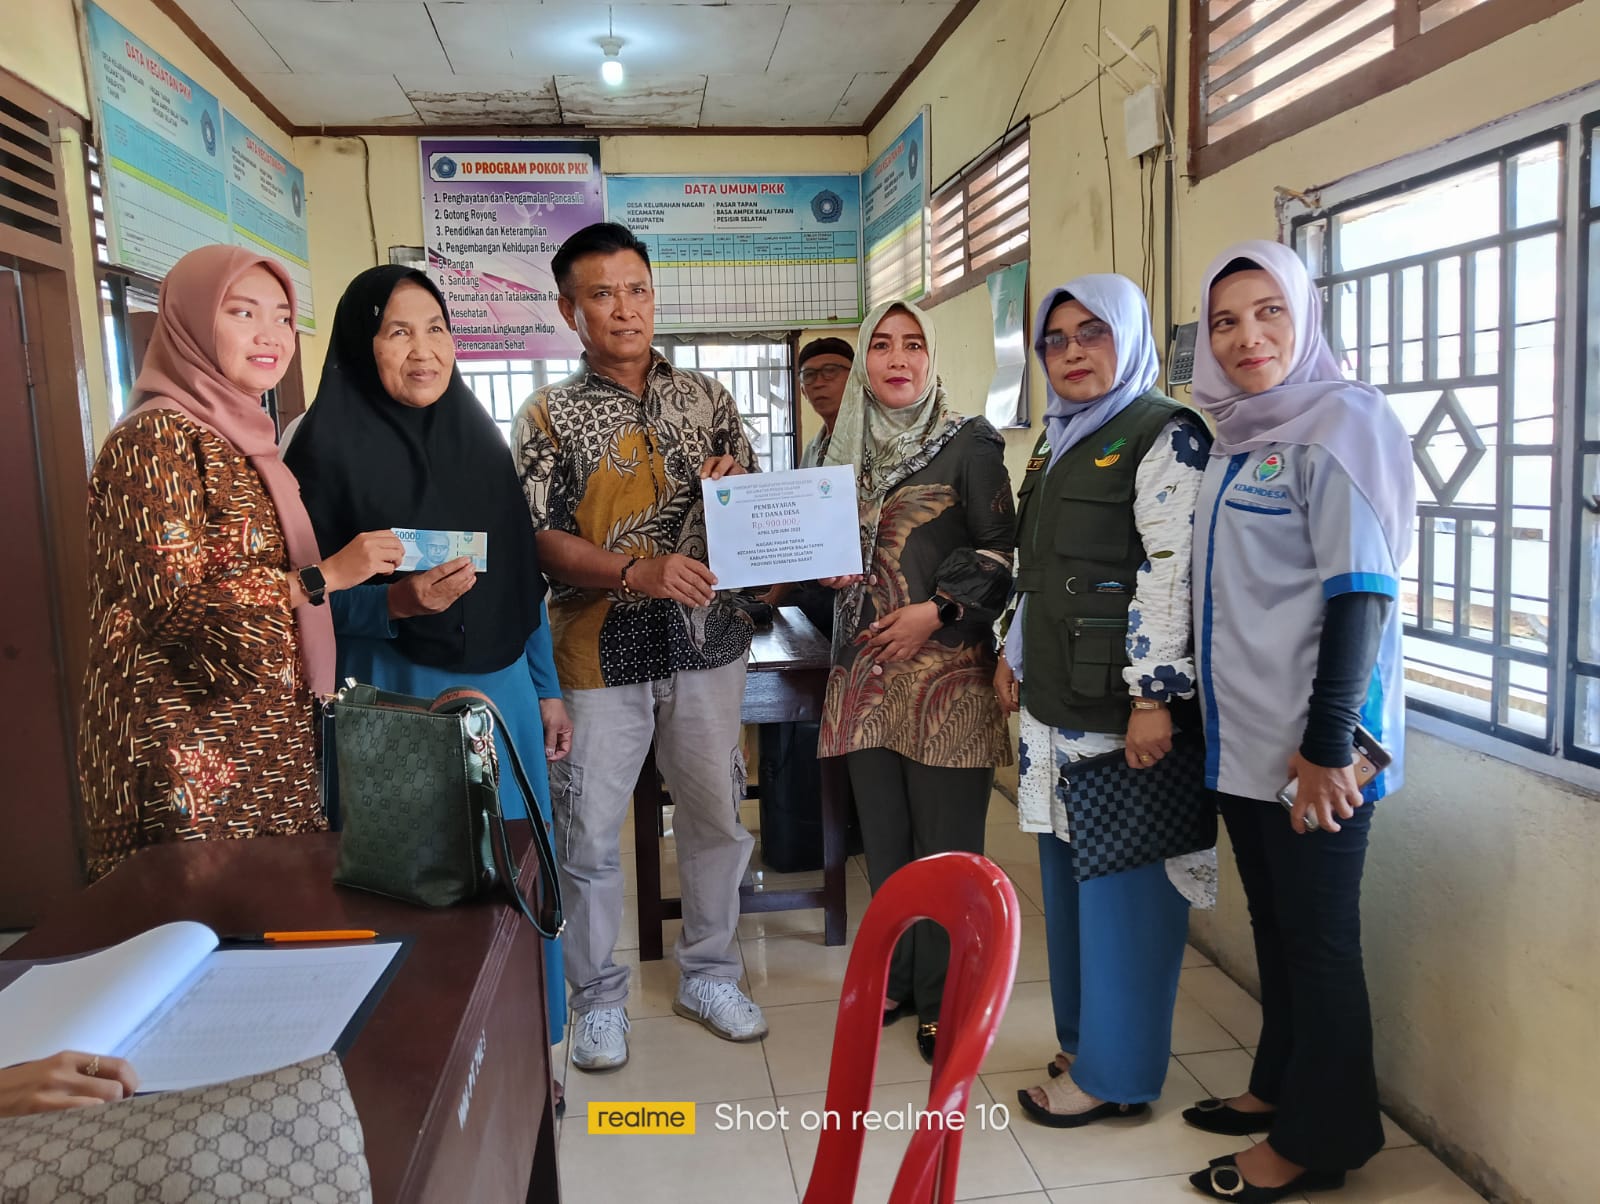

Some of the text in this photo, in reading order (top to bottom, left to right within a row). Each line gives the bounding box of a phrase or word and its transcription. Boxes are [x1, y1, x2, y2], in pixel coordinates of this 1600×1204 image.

[462, 162, 588, 174] 10 PROGRAM POKOK PKK
[684, 184, 785, 194] DATA UMUM PKK
[434, 193, 584, 206] 1. Penghayatan dan Pengamalan Pancasila
[435, 210, 497, 221] 2. Gotong Royong
[436, 226, 546, 238] 3. Pendidikan dan Keterampilan
[437, 242, 561, 254] 4. Pengembangan Kehidupan Berko
[438, 260, 473, 270] 5. Pangan
[440, 276, 479, 287] 6. Sandang
[449, 292, 488, 302] Perumahan
[490, 292, 502, 302] dan
[505, 291, 546, 302] Tatalaksana
[548, 291, 559, 302] Ru
[451, 308, 488, 318] Kesehatan
[452, 324, 555, 336] Kelestarian Lingkungan Hidup
[458, 340, 525, 350] Perencanaan Sehat
